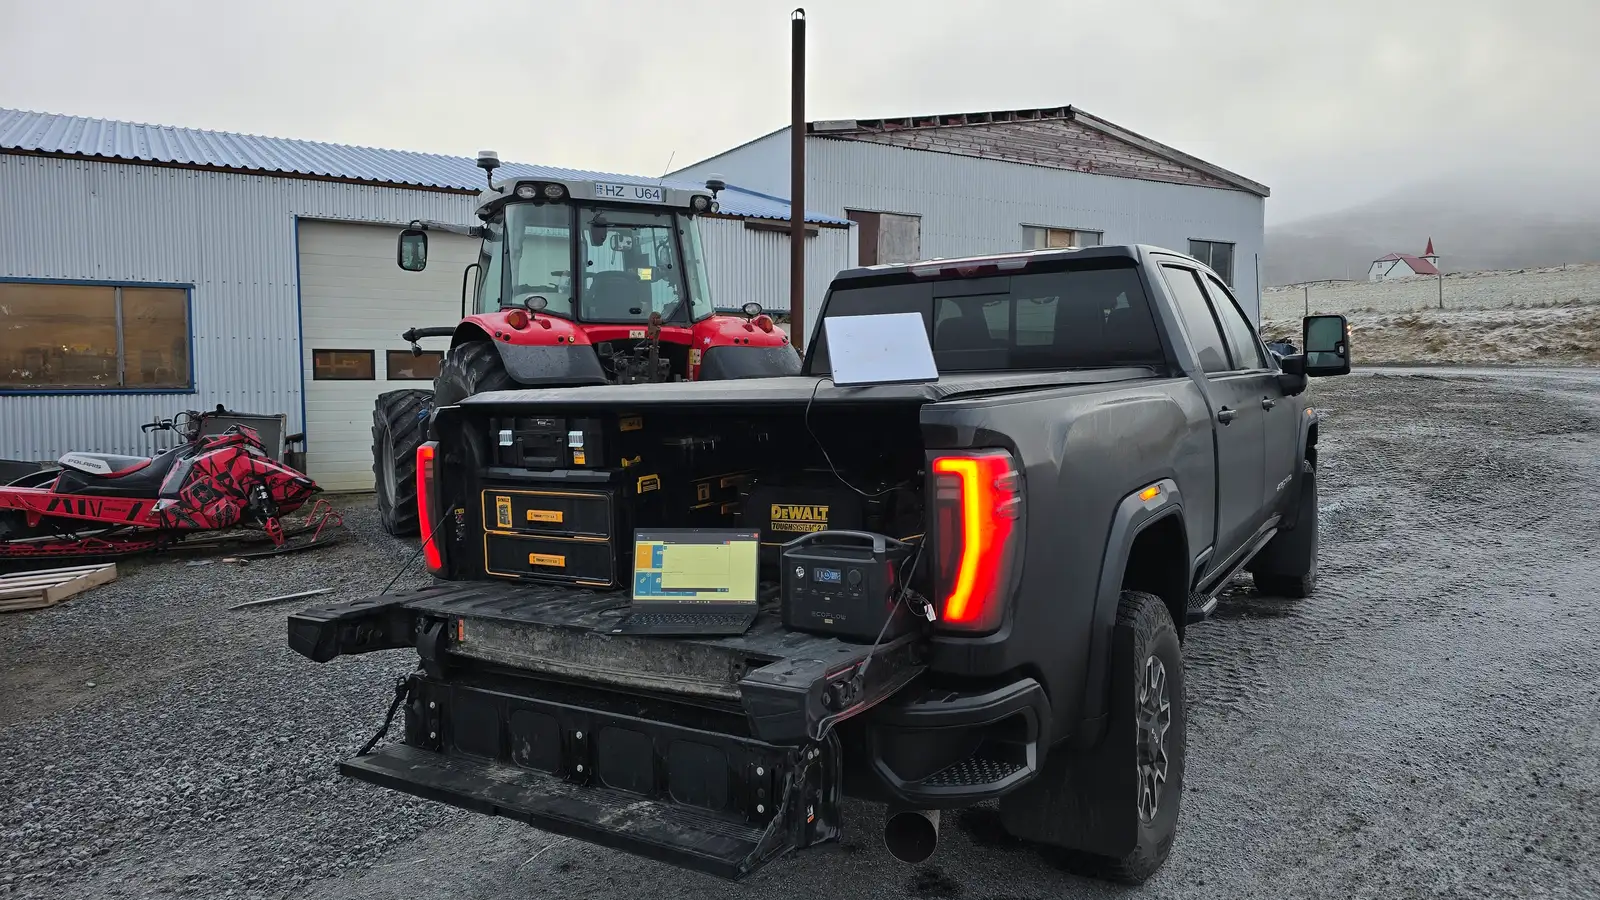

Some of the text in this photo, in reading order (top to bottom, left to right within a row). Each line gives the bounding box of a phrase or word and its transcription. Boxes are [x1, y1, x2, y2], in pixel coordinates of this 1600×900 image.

[605, 184, 624, 197] HZ
[635, 188, 660, 200] U64
[68, 458, 102, 469] POLARIS
[812, 610, 846, 620] ECOFLOW
